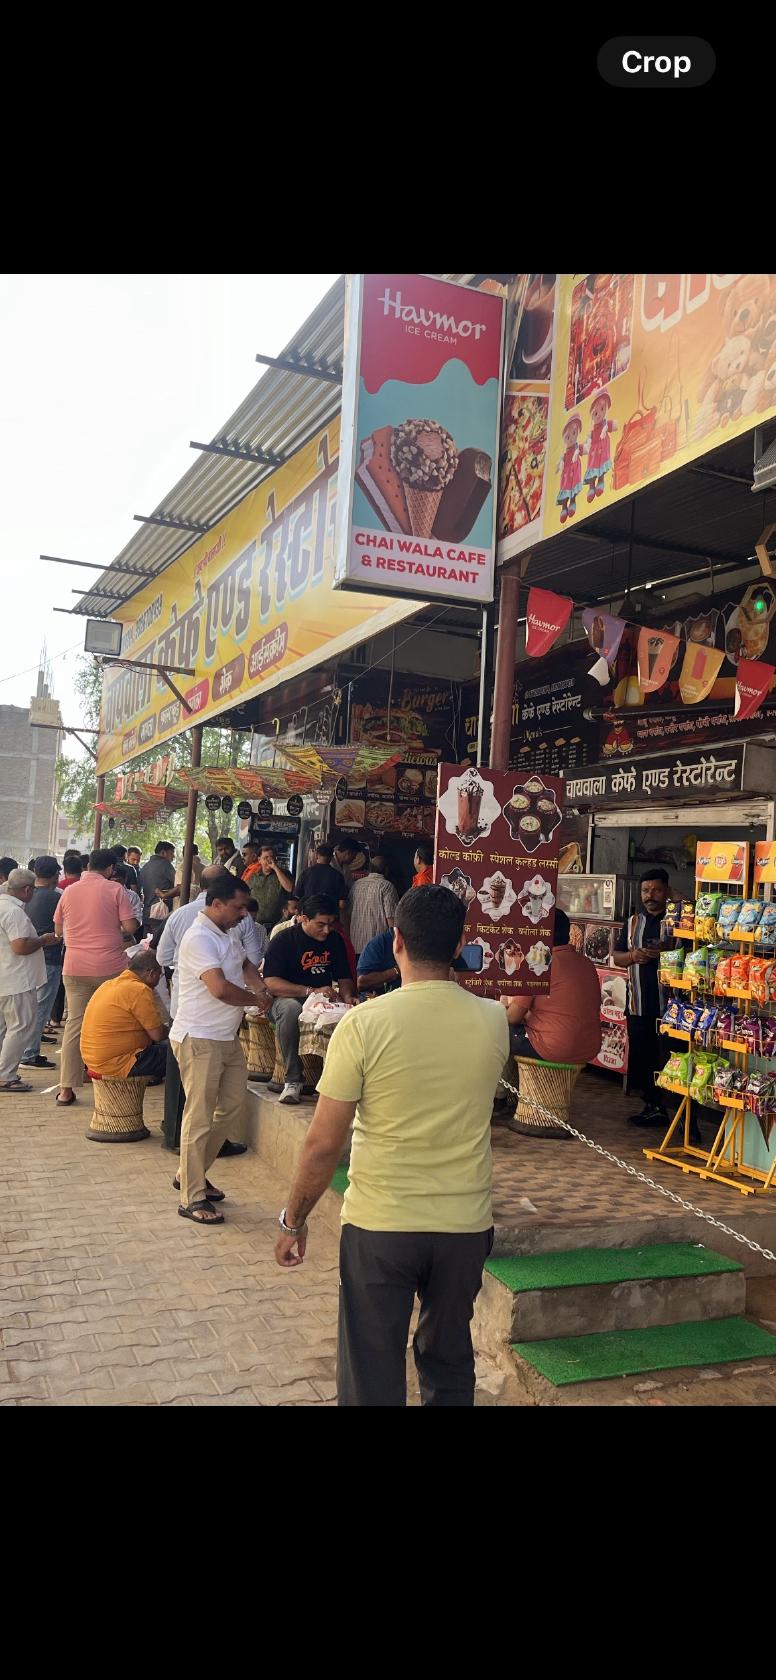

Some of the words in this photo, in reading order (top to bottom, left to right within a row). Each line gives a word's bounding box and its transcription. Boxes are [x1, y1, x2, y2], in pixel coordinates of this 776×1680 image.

[377, 288, 487, 340] Havmor
[404, 324, 421, 337] ICE
[423, 328, 458, 346] CREAM
[354, 532, 394, 550] CHAI
[396, 538, 443, 560] WALA
[446, 548, 487, 566] CAFE
[361, 554, 372, 567] &
[375, 556, 480, 585] RESTAURANT
[528, 613, 561, 632] Havmor
[737, 681, 763, 698] Havmor
[536, 703, 551, 720] एण्ड
[565, 776, 607, 799] चायवाला
[611, 766, 637, 793] केफे
[642, 768, 671, 795] एण्ड
[672, 755, 738, 788] रेस्टोरेन्ट
[438, 847, 460, 862] कोल्ड
[489, 850, 514, 866] स्पेशल
[538, 857, 559, 869] लस्सी
